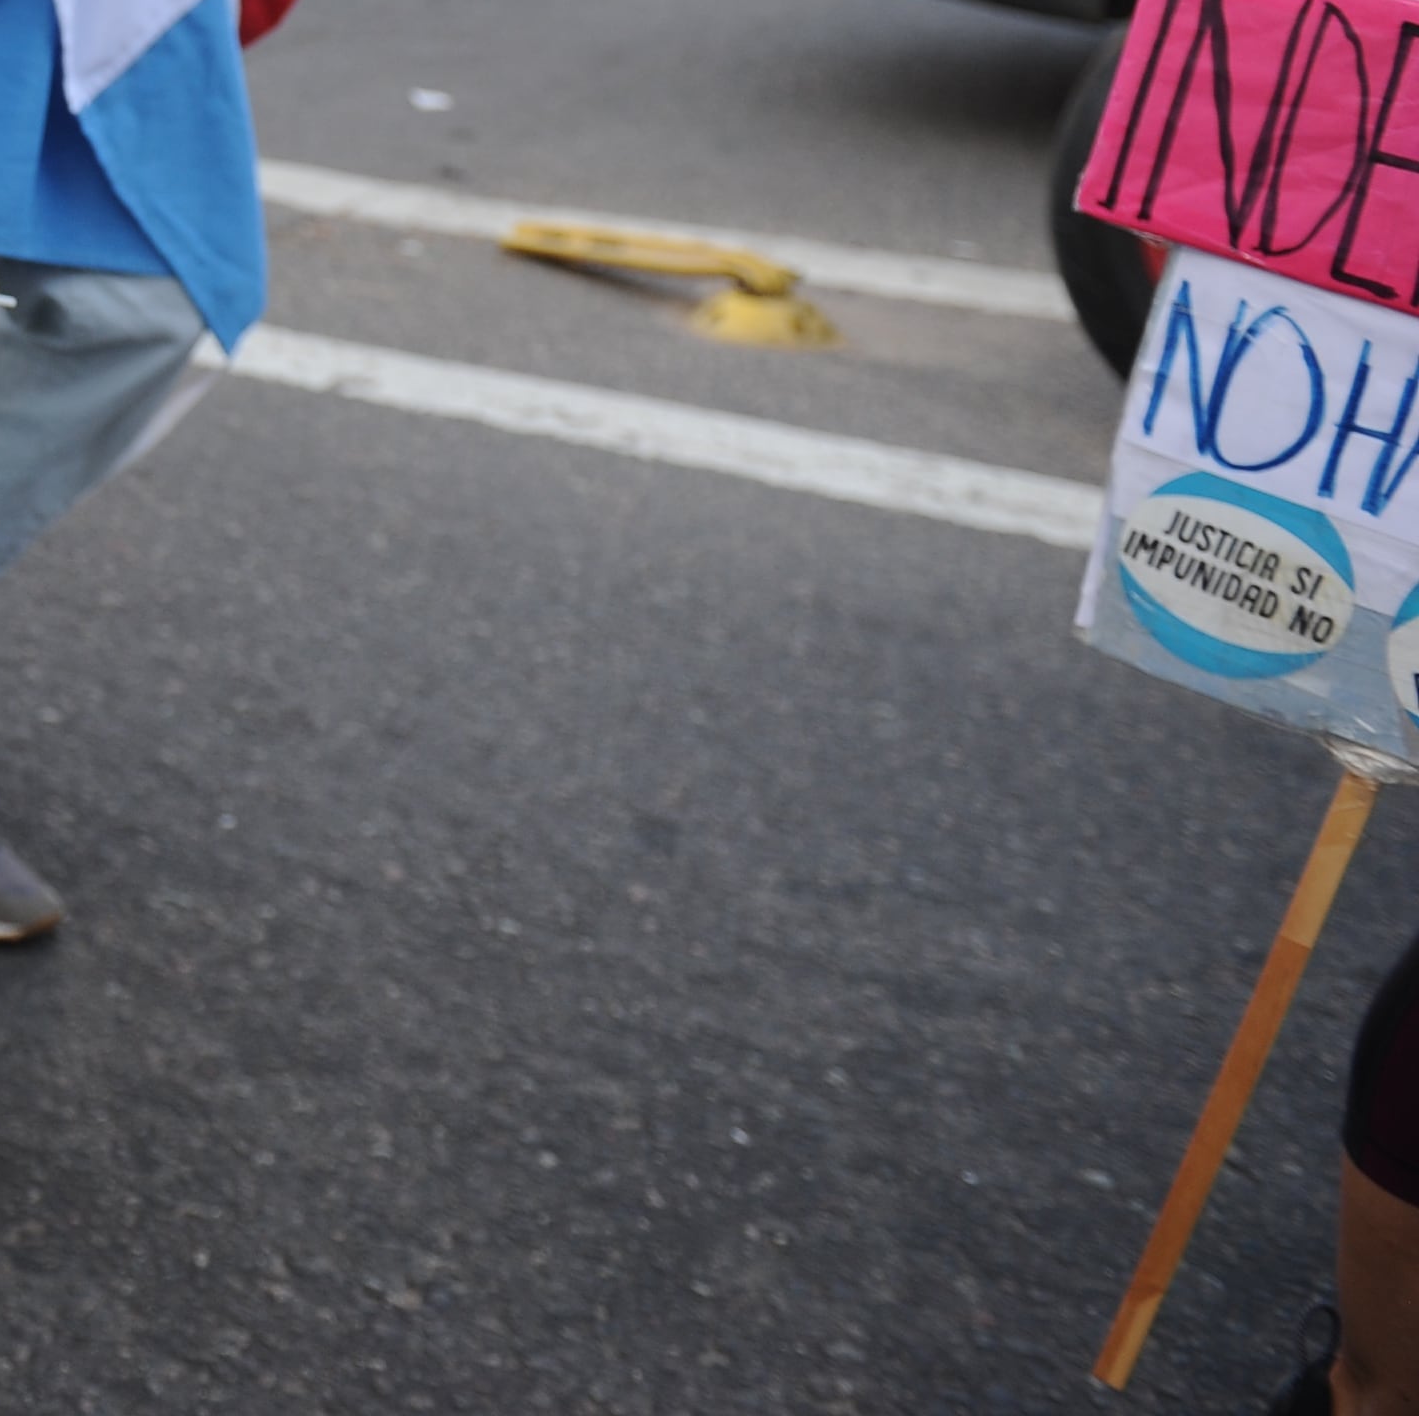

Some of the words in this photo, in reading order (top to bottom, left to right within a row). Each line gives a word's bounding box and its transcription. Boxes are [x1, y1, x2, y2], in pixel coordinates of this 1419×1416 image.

[1123, 530, 1280, 620] IMPUNIDAD
[1288, 604, 1335, 645] NO
[1164, 509, 1281, 582] JUSTICIA
[1290, 566, 1324, 601] SI
